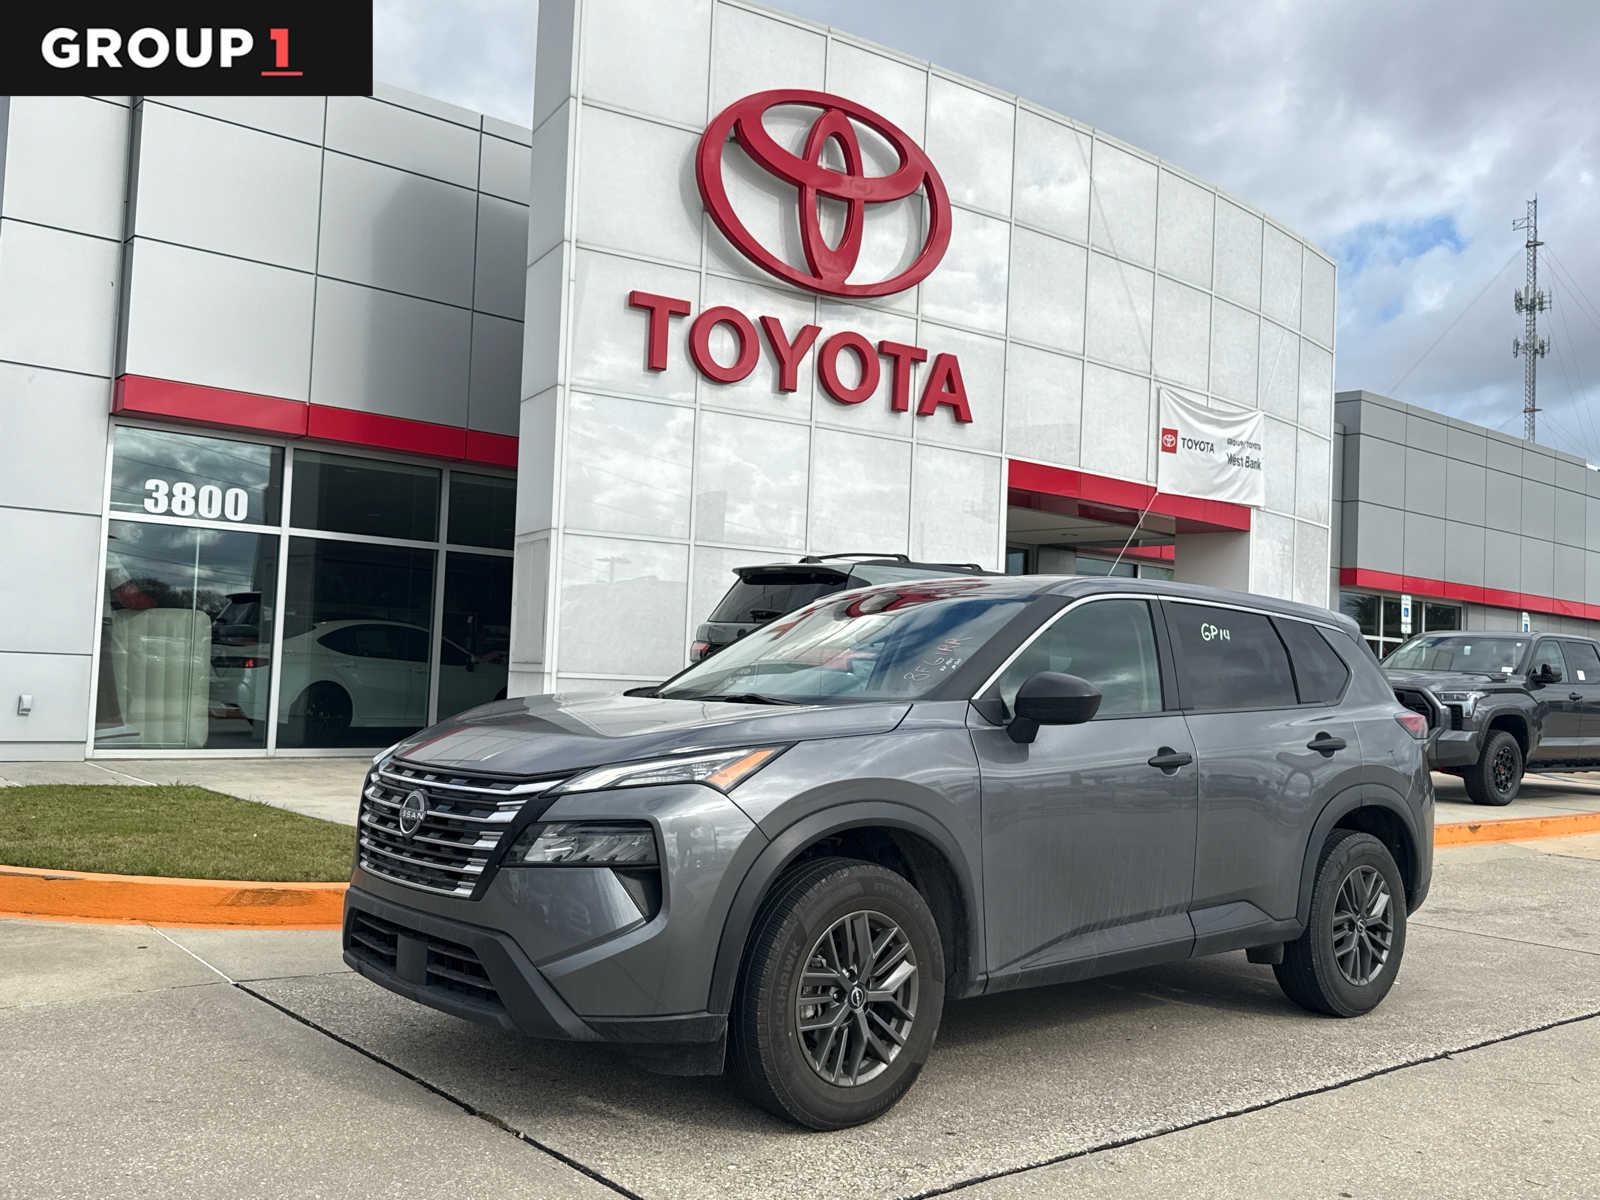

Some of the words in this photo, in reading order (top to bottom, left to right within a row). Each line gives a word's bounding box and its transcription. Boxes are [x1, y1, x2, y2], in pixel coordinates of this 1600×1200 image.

[628, 290, 974, 424] TOYOTA
[1181, 437, 1215, 454] TOYOTA
[1226, 453, 1244, 468] West
[1245, 455, 1262, 470] Bank
[143, 478, 249, 522] 3800
